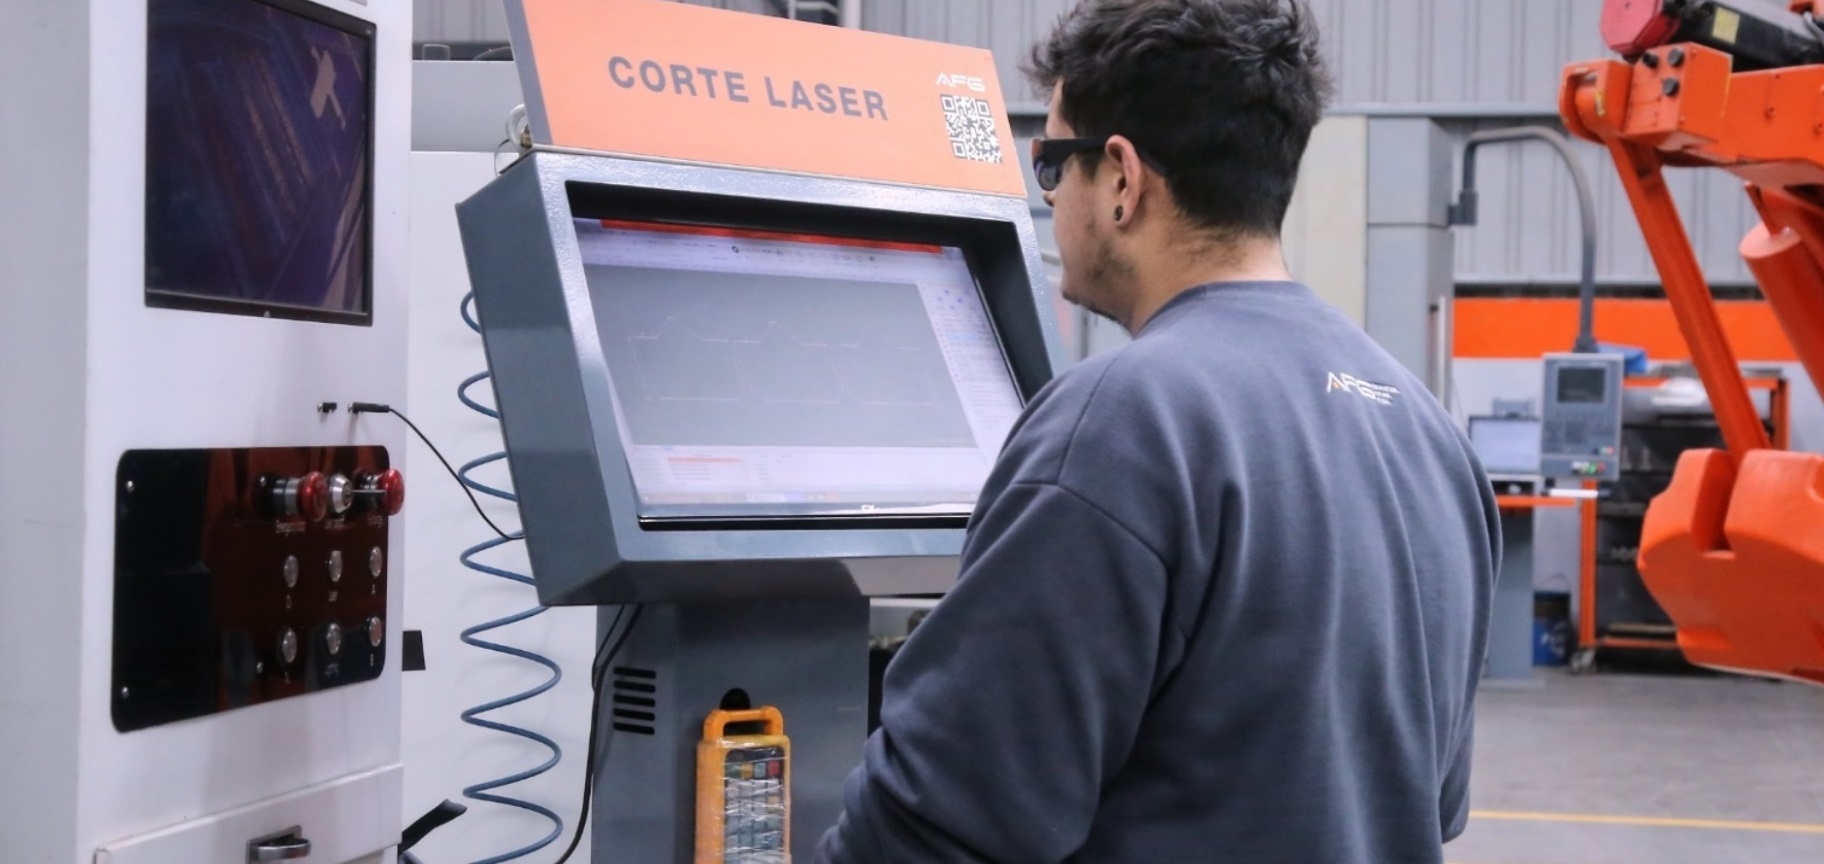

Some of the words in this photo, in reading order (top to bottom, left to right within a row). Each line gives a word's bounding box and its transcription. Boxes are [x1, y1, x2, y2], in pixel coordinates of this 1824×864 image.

[608, 55, 749, 103] CORTE
[764, 76, 888, 121] LASER
[936, 72, 986, 92] AFG
